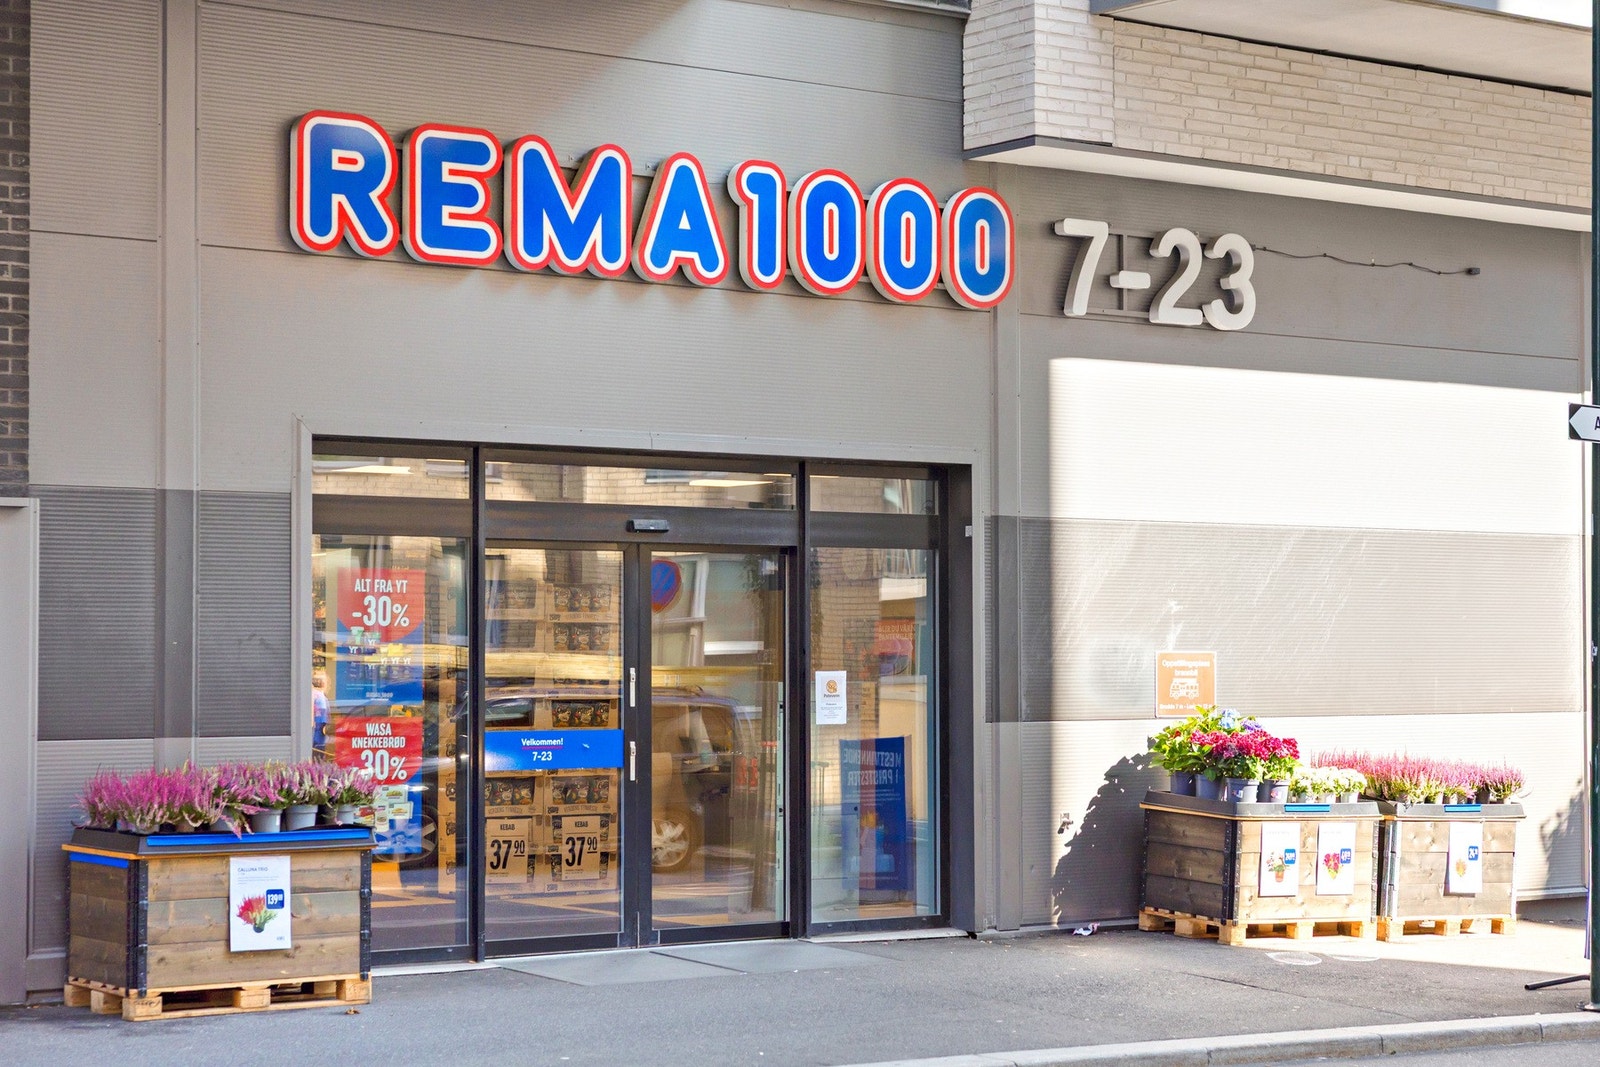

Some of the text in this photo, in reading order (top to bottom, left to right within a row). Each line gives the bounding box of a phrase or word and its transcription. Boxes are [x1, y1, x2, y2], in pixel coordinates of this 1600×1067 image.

[1055, 217, 1257, 331] 7-23
[354, 578, 408, 593] ALT FRA YT
[351, 595, 410, 627] -30%
[365, 722, 392, 737] WASA
[351, 736, 406, 749] KNEKKEBRØD
[521, 738, 564, 746] Velkommen!
[532, 751, 553, 761] 7-23
[500, 823, 516, 831] KEBAB
[574, 820, 589, 828] KEBAB
[489, 839, 526, 870] 37 90
[565, 836, 598, 867] 37 90
